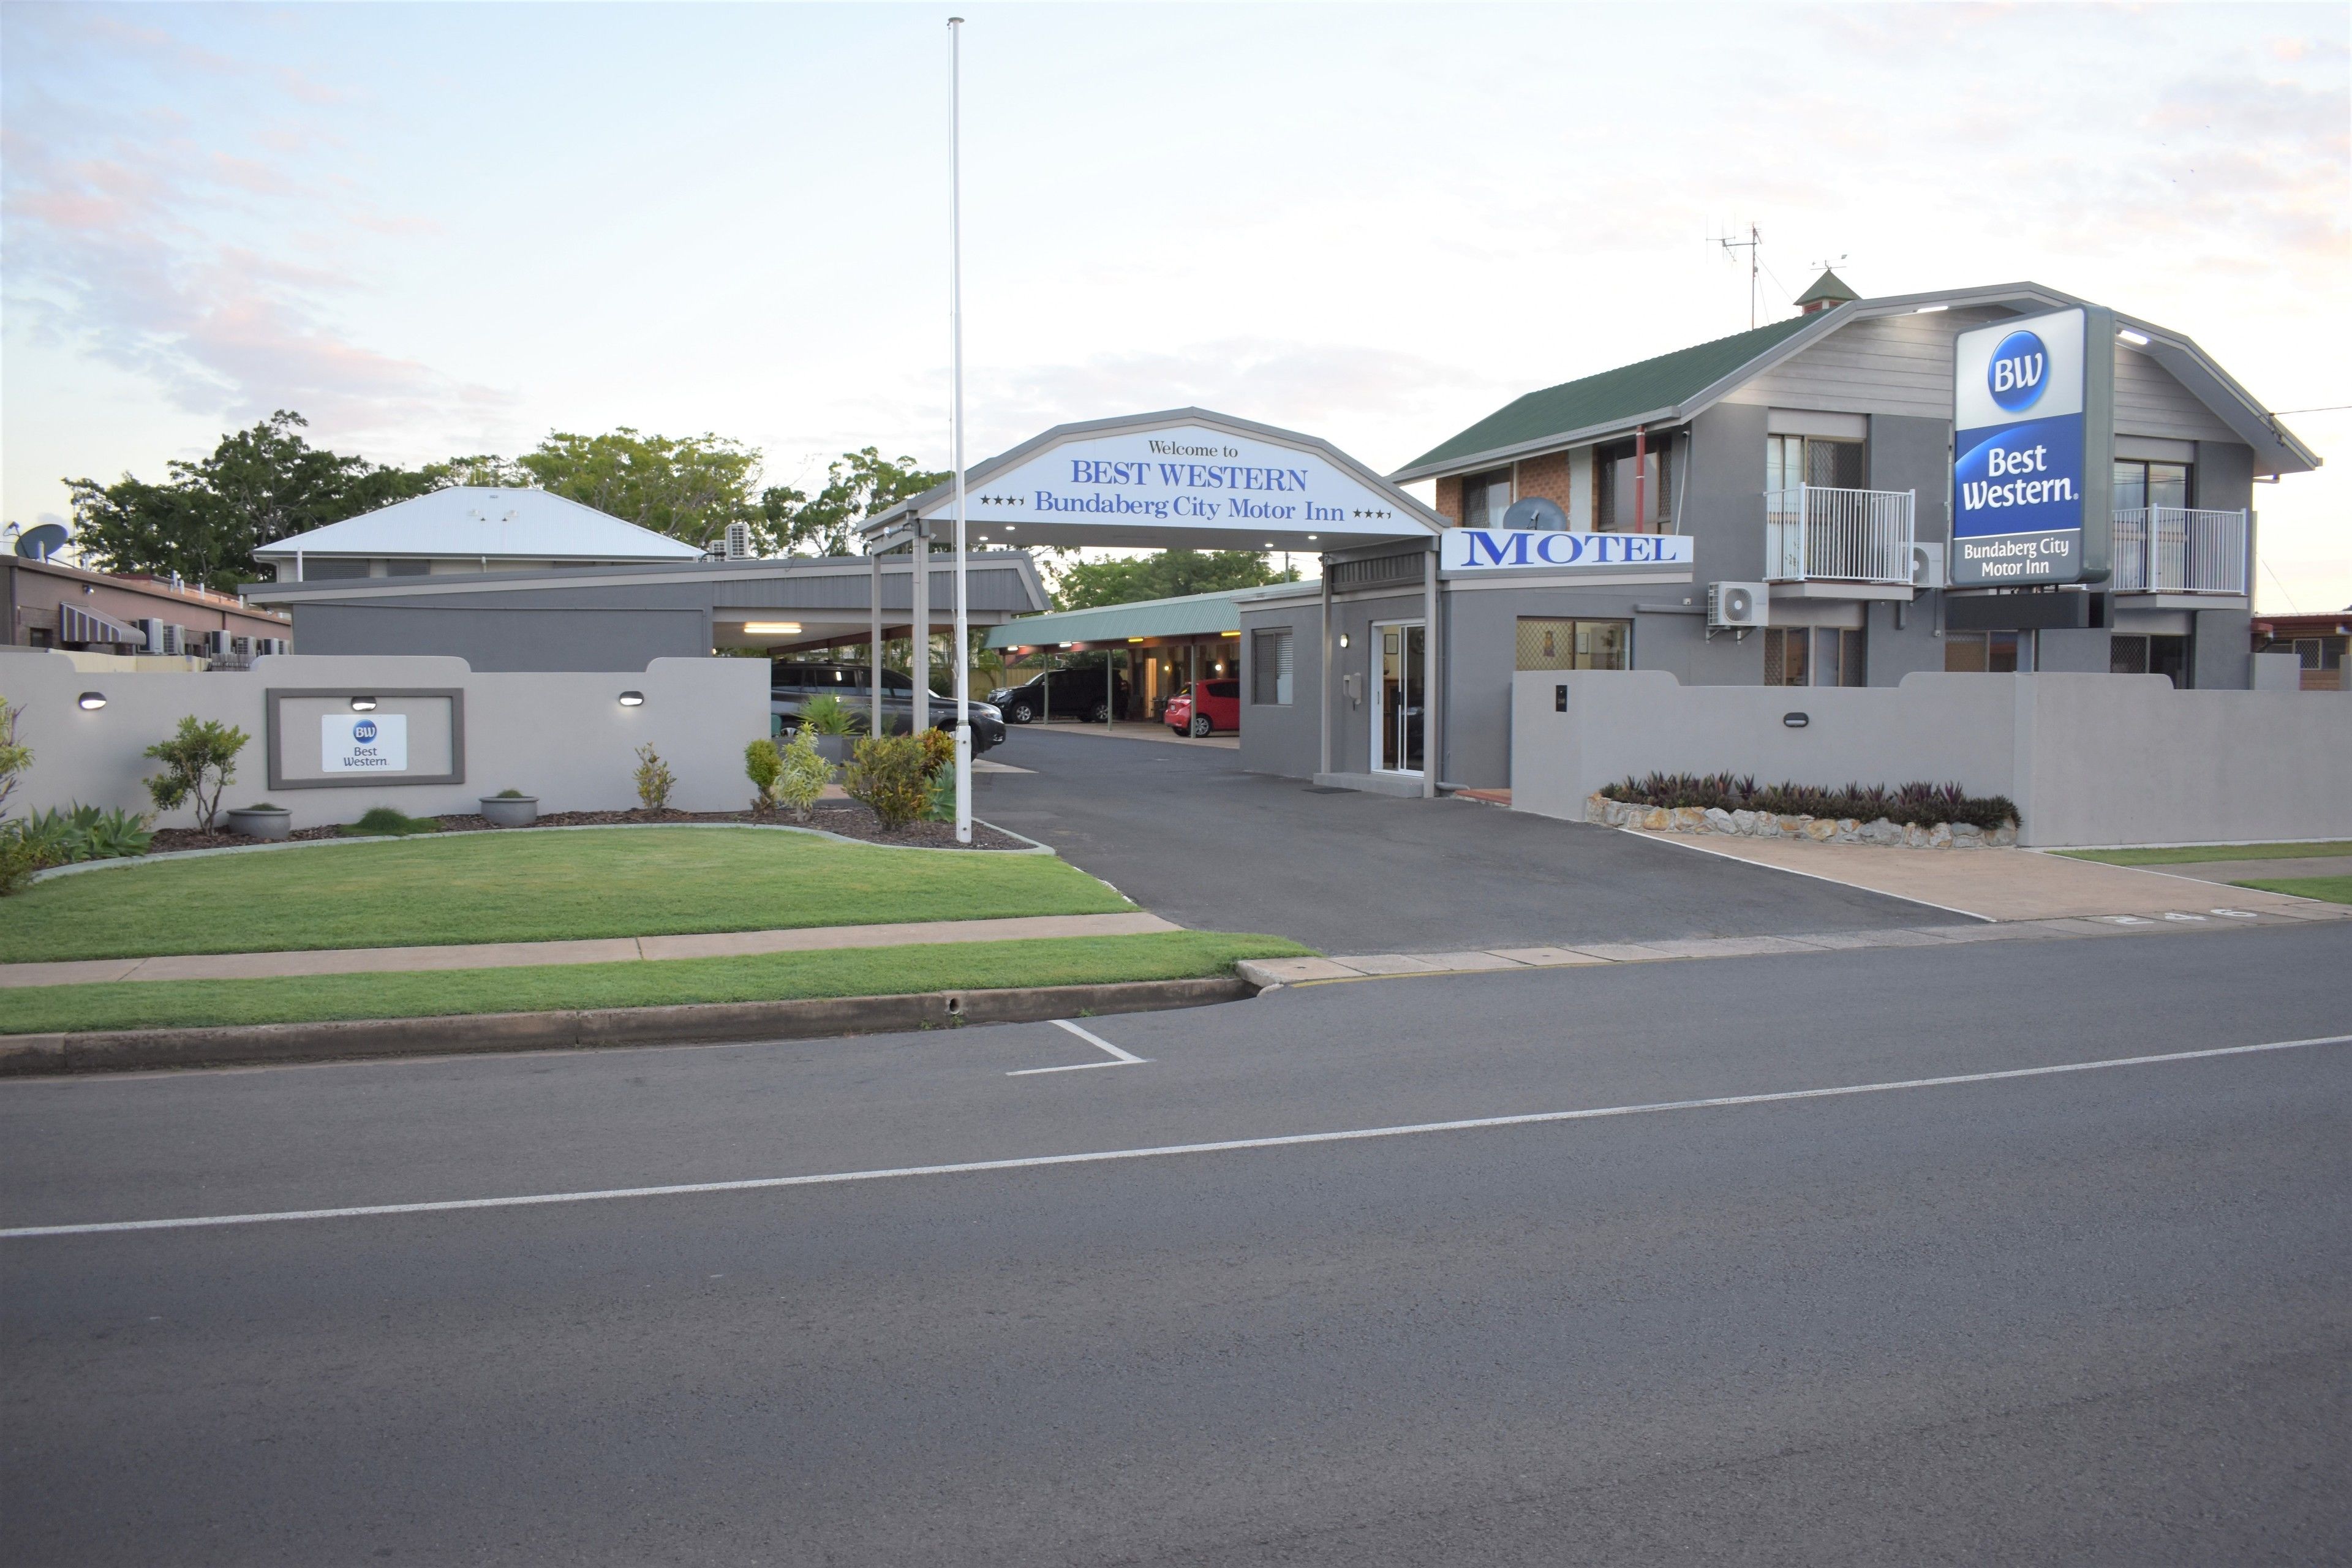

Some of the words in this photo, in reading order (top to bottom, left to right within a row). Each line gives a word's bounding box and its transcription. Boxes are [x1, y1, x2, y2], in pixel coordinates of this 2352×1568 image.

[1994, 352, 2043, 393] BW
[1148, 440, 1218, 457] Welcome
[1223, 445, 1238, 458] to
[1988, 444, 2047, 477] Best
[1071, 460, 1151, 485] BEST
[1158, 464, 1308, 492] WESTERN
[1035, 491, 1169, 519] Bundaberg
[1174, 496, 1221, 521] City
[1228, 498, 1296, 519] Motor
[1305, 501, 1345, 521] Inn
[1460, 530, 1677, 567] MOTEL
[1964, 540, 2037, 559] Bundaberg
[2040, 537, 2069, 557] City
[1981, 562, 2023, 577] Motor
[2026, 560, 2049, 575] Inn
[356, 726, 375, 737] BW
[344, 757, 387, 766] Western
[354, 747, 378, 756] Best
